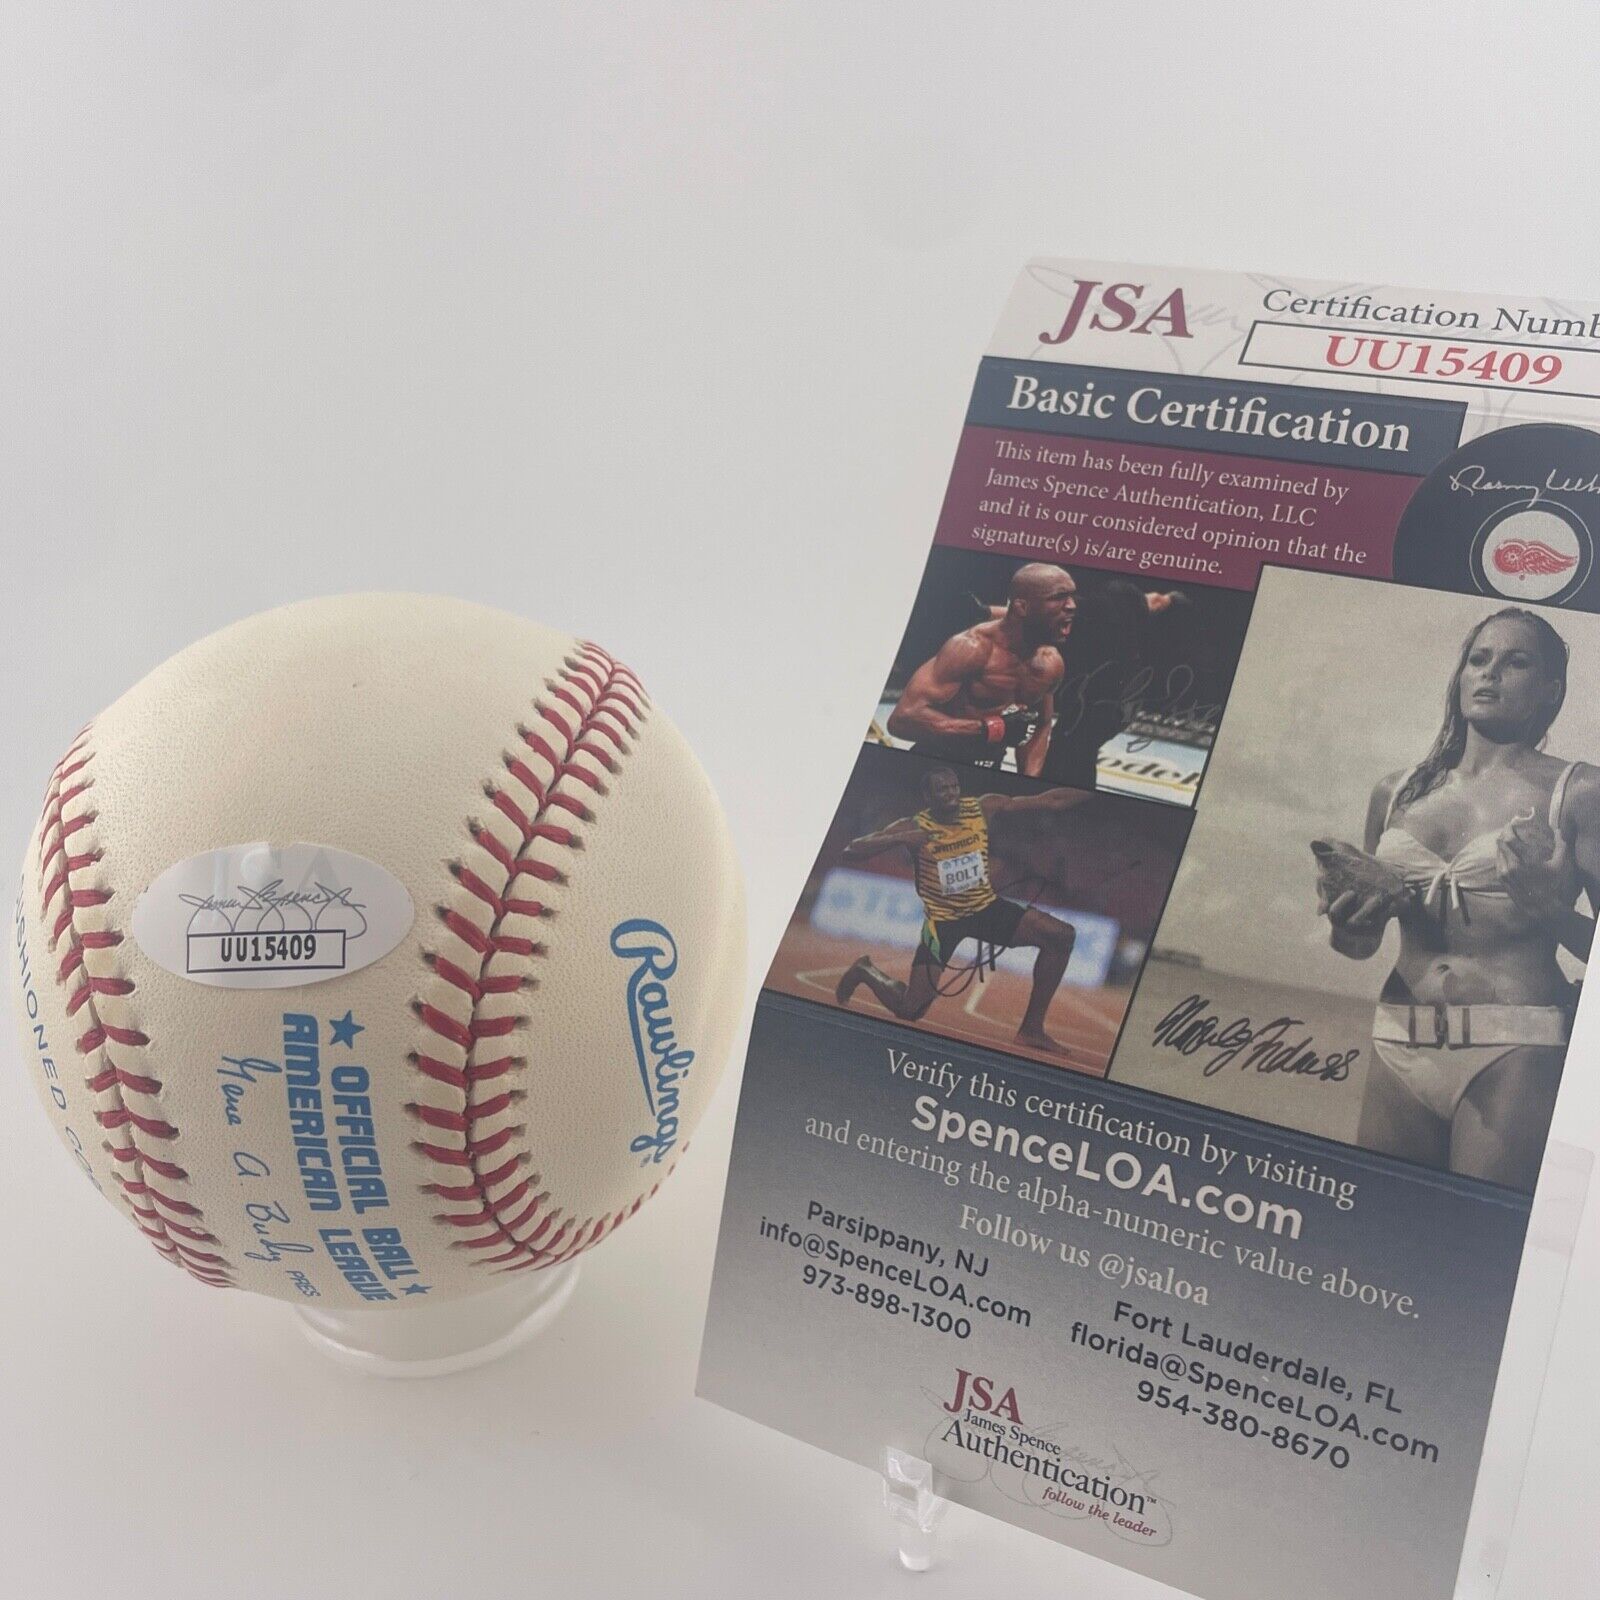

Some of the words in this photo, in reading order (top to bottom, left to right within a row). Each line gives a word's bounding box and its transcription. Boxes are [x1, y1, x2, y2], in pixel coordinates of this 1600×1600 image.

[1038, 280, 1194, 344] JSA
[1263, 289, 1480, 329] Certification
[1325, 335, 1563, 385] UU15409
[1007, 375, 1115, 419] Basic
[1127, 387, 1410, 452] Certification
[985, 467, 1039, 488] James
[1043, 474, 1109, 499] Spence
[1113, 483, 1264, 522] Authentication,
[1270, 503, 1318, 527] LLC
[995, 440, 1032, 461] This
[1036, 446, 1076, 467] item
[1082, 449, 1113, 472] has
[1119, 454, 1163, 478] been
[1169, 460, 1215, 489] fully
[1218, 472, 1319, 497] examined
[1323, 479, 1350, 506] by
[971, 523, 1080, 557] signature(s)
[1084, 537, 1138, 562] is/are
[1138, 550, 1223, 576] genuine.
[978, 497, 1014, 515] and
[1017, 500, 1031, 518] it
[1035, 502, 1050, 521] is
[1055, 509, 1089, 526] our
[1092, 514, 1199, 542] considered
[1202, 528, 1280, 554] opinion
[1287, 536, 1330, 560] that
[1333, 542, 1367, 565] the
[945, 864, 979, 885] BOLT
[220, 934, 317, 963] UU15409
[610, 918, 696, 1164] Rawlings
[283, 1012, 342, 1211] AMERICAN
[318, 1228, 398, 1301] LEAGUE
[887, 1048, 963, 1098] Verify
[970, 1072, 1018, 1107] this
[1025, 1094, 1191, 1158] certification
[1202, 1134, 1238, 1176] by
[1245, 1153, 1358, 1211] visiting
[911, 1095, 1303, 1240] SpenceLOA.com
[331, 1065, 390, 1214] OFFICIAL
[361, 1227, 420, 1280] BALL
[805, 1117, 851, 1145] and
[857, 1132, 963, 1186] entering
[970, 1160, 1011, 1194] the
[1017, 1176, 1226, 1259] alpha-numeric
[1234, 1245, 1313, 1286] value
[1321, 1267, 1420, 1320] above.
[807, 1200, 945, 1268] Parsippany,
[955, 1249, 990, 1278] NJ
[959, 1204, 1054, 1255] Follow
[1058, 1243, 1091, 1268] us
[1099, 1253, 1210, 1306] @jsaloa
[759, 1216, 1032, 1328] info@SpenceLOA.com
[802, 1264, 972, 1340] 973-898-1300
[1071, 1321, 1439, 1463] florida@SpenceLOA.com
[1113, 1300, 1173, 1339] Fort
[1181, 1322, 1354, 1402] Lauderdale,
[1364, 1380, 1403, 1414] FL
[943, 1368, 1024, 1426] JSA
[963, 1408, 1007, 1436] James
[1009, 1425, 1061, 1456] Spence
[1136, 1380, 1350, 1470] 954-380-8670
[1043, 1486, 1086, 1513] follow
[1088, 1503, 1110, 1521] the
[1112, 1513, 1157, 1538] leader
